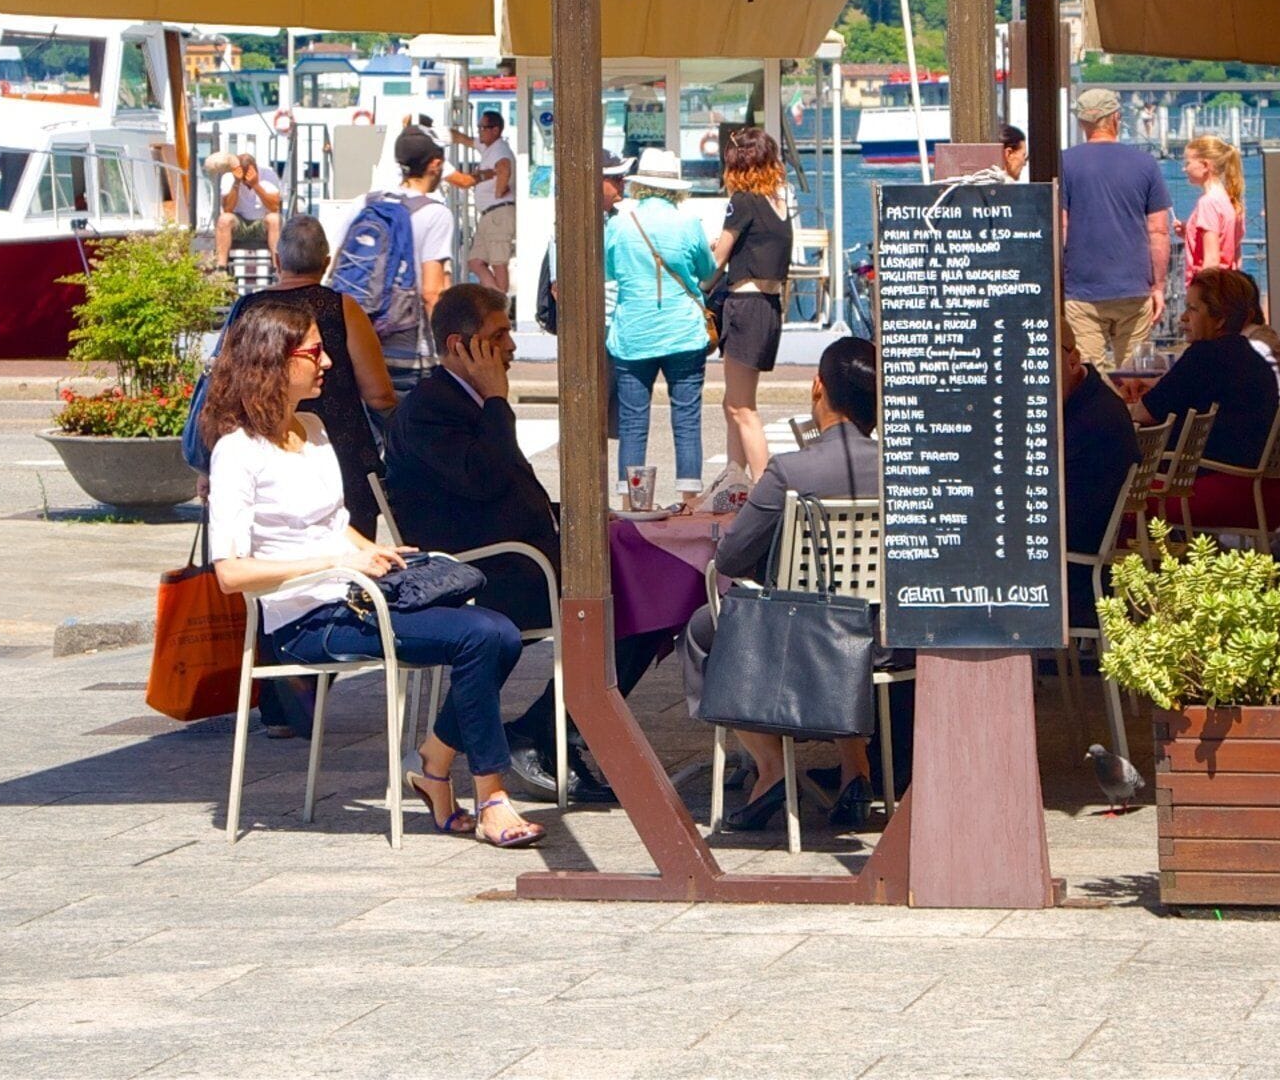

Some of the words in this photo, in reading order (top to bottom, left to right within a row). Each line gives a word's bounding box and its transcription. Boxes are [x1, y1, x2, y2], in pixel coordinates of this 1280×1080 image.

[972, 206, 1013, 218] MONTI
[884, 230, 910, 240] PRIMI
[878, 242, 929, 255] SPAGHETTI
[934, 243, 947, 254] AL
[949, 242, 1000, 254] POMODORO
[881, 257, 924, 268] LASAGNE
[929, 258, 942, 267] AL
[880, 270, 937, 282] TAGLIATELLE
[941, 269, 963, 282] ALLA
[966, 269, 1020, 281] BOLOGNESE
[942, 284, 976, 296] PANNA
[881, 298, 926, 310] FARFALLE
[930, 298, 943, 309] AL
[946, 298, 990, 309] SALMONE
[883, 320, 933, 330] BRESAOLA
[943, 319, 977, 330] RUCOLA
[882, 333, 928, 345] INSALATA
[934, 333, 964, 344] MISTA
[883, 361, 916, 374] PIATTO
[920, 361, 949, 373] MONTI
[949, 375, 987, 385] MELONE
[884, 396, 918, 406] PANINI
[884, 423, 911, 435] PIZZA
[915, 424, 928, 433] AL
[929, 423, 972, 434] TRANCIO
[884, 436, 913, 449] TOAST
[884, 451, 913, 463] TOAST
[886, 485, 929, 497] TRANCIO
[931, 486, 942, 497] DI
[945, 485, 974, 497] TORTA
[939, 514, 968, 525] PASTE
[935, 533, 961, 546] TUTTI
[898, 586, 944, 604] GELATI
[951, 585, 988, 604] TUTTI
[996, 587, 1002, 602] I
[1007, 584, 1049, 603] GUSTI
